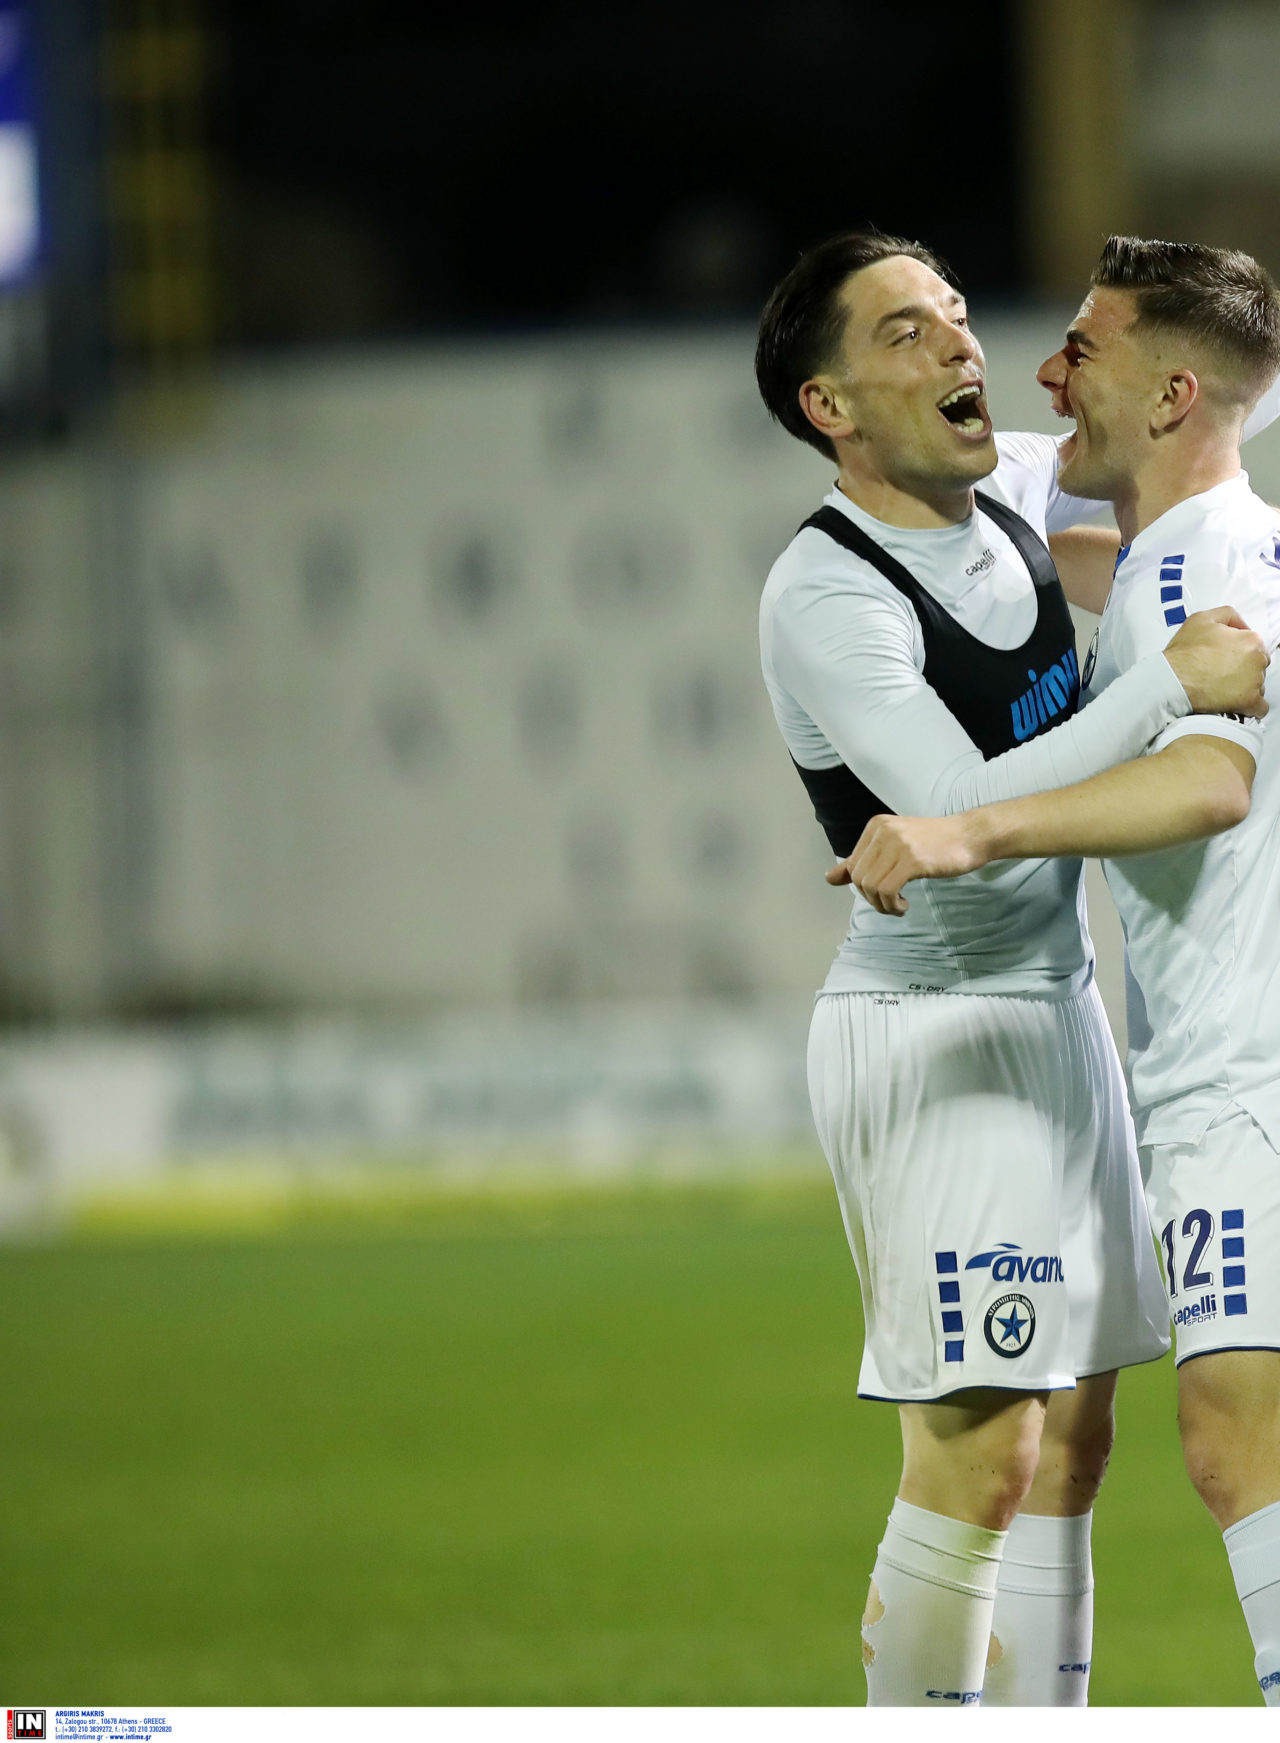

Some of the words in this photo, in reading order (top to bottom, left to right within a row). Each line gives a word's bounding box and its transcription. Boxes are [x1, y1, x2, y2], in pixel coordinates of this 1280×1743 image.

[1162, 1209, 1214, 1298] 12
[1174, 1294, 1216, 1325] capelli
[1187, 1312, 1217, 1326] SPORT
